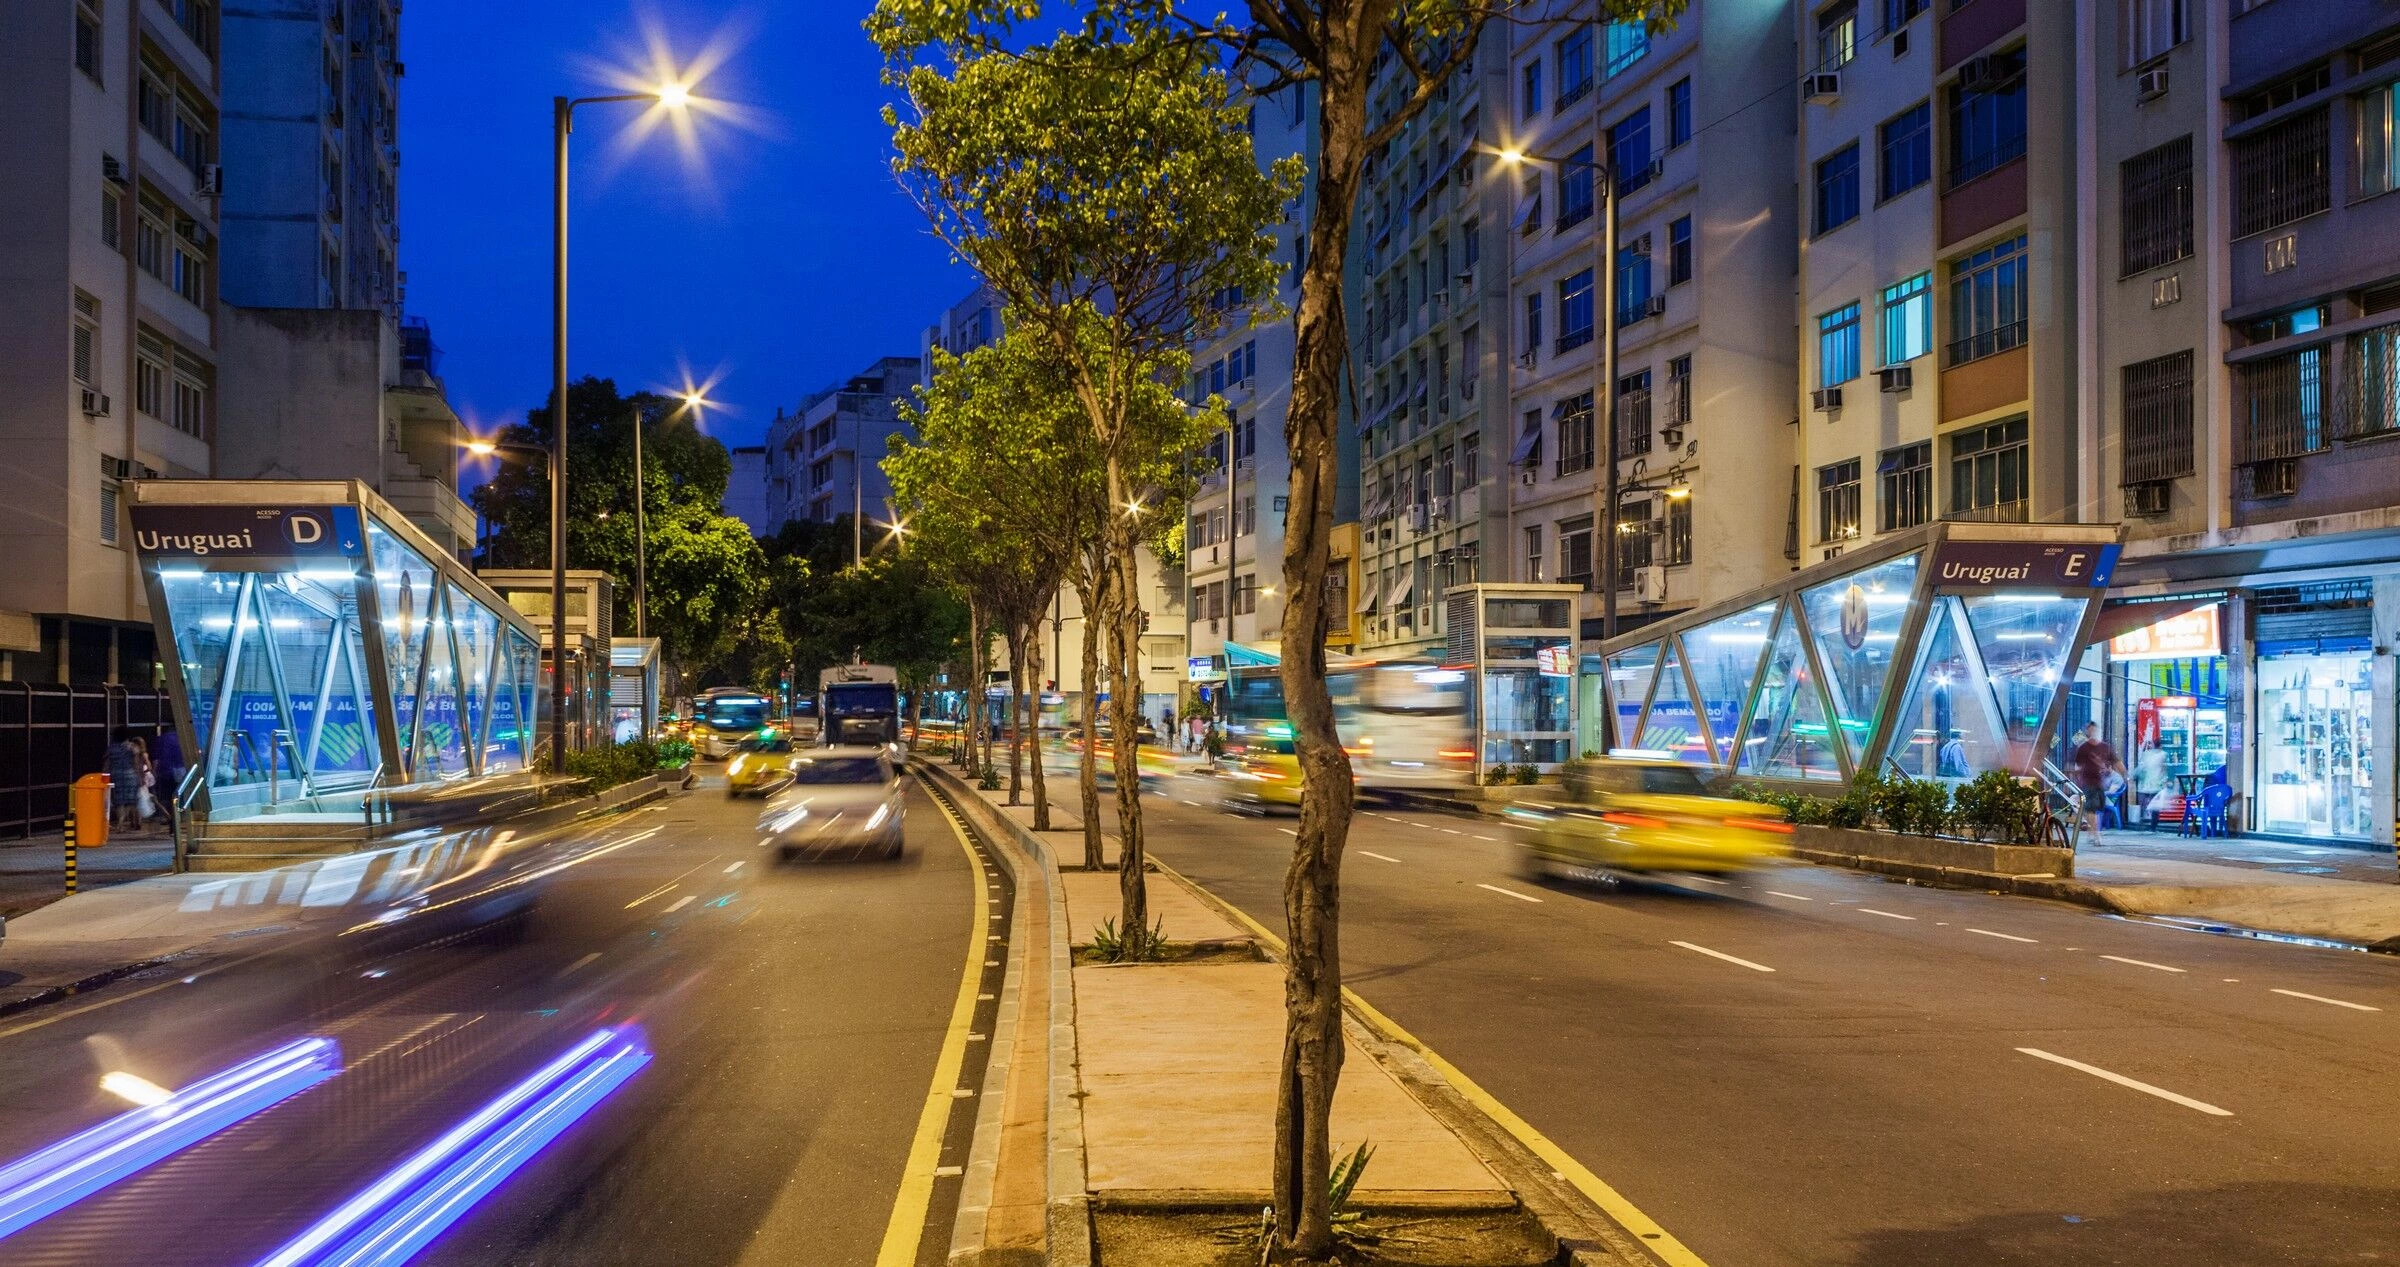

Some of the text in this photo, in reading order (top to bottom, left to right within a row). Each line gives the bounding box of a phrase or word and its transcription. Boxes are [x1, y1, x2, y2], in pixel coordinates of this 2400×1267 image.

[137, 528, 253, 555] Uruguai
[290, 516, 322, 544] D
[1942, 562, 2031, 585] Uruguai
[2064, 554, 2086, 577] E
